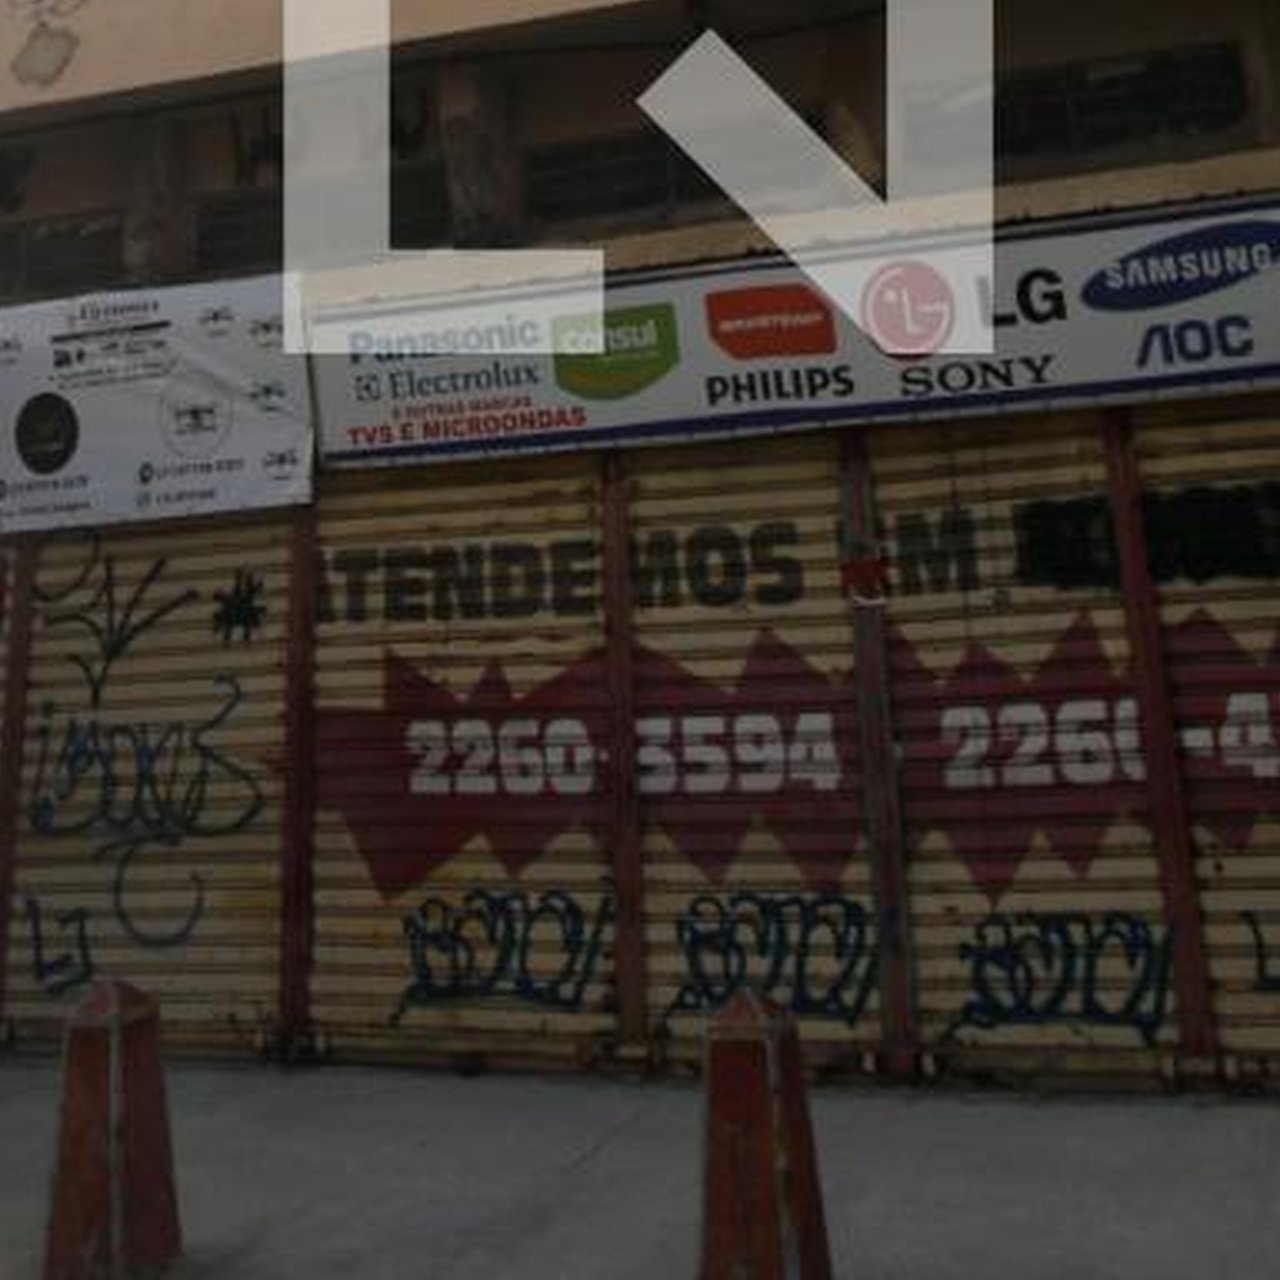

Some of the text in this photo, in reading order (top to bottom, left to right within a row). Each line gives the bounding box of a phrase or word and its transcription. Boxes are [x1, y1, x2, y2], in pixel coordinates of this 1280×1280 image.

[1101, 242, 1272, 290] SAMSUNG
[976, 269, 1067, 327] LG
[348, 318, 541, 363] Panasonic
[1137, 317, 1253, 367] AOC
[389, 361, 541, 398] Electrolux
[706, 366, 854, 405] PHILIPS
[901, 356, 1053, 397] SONY
[347, 406, 587, 444] TVS E MICROONDAS
[318, 524, 804, 621] TENDEMOS
